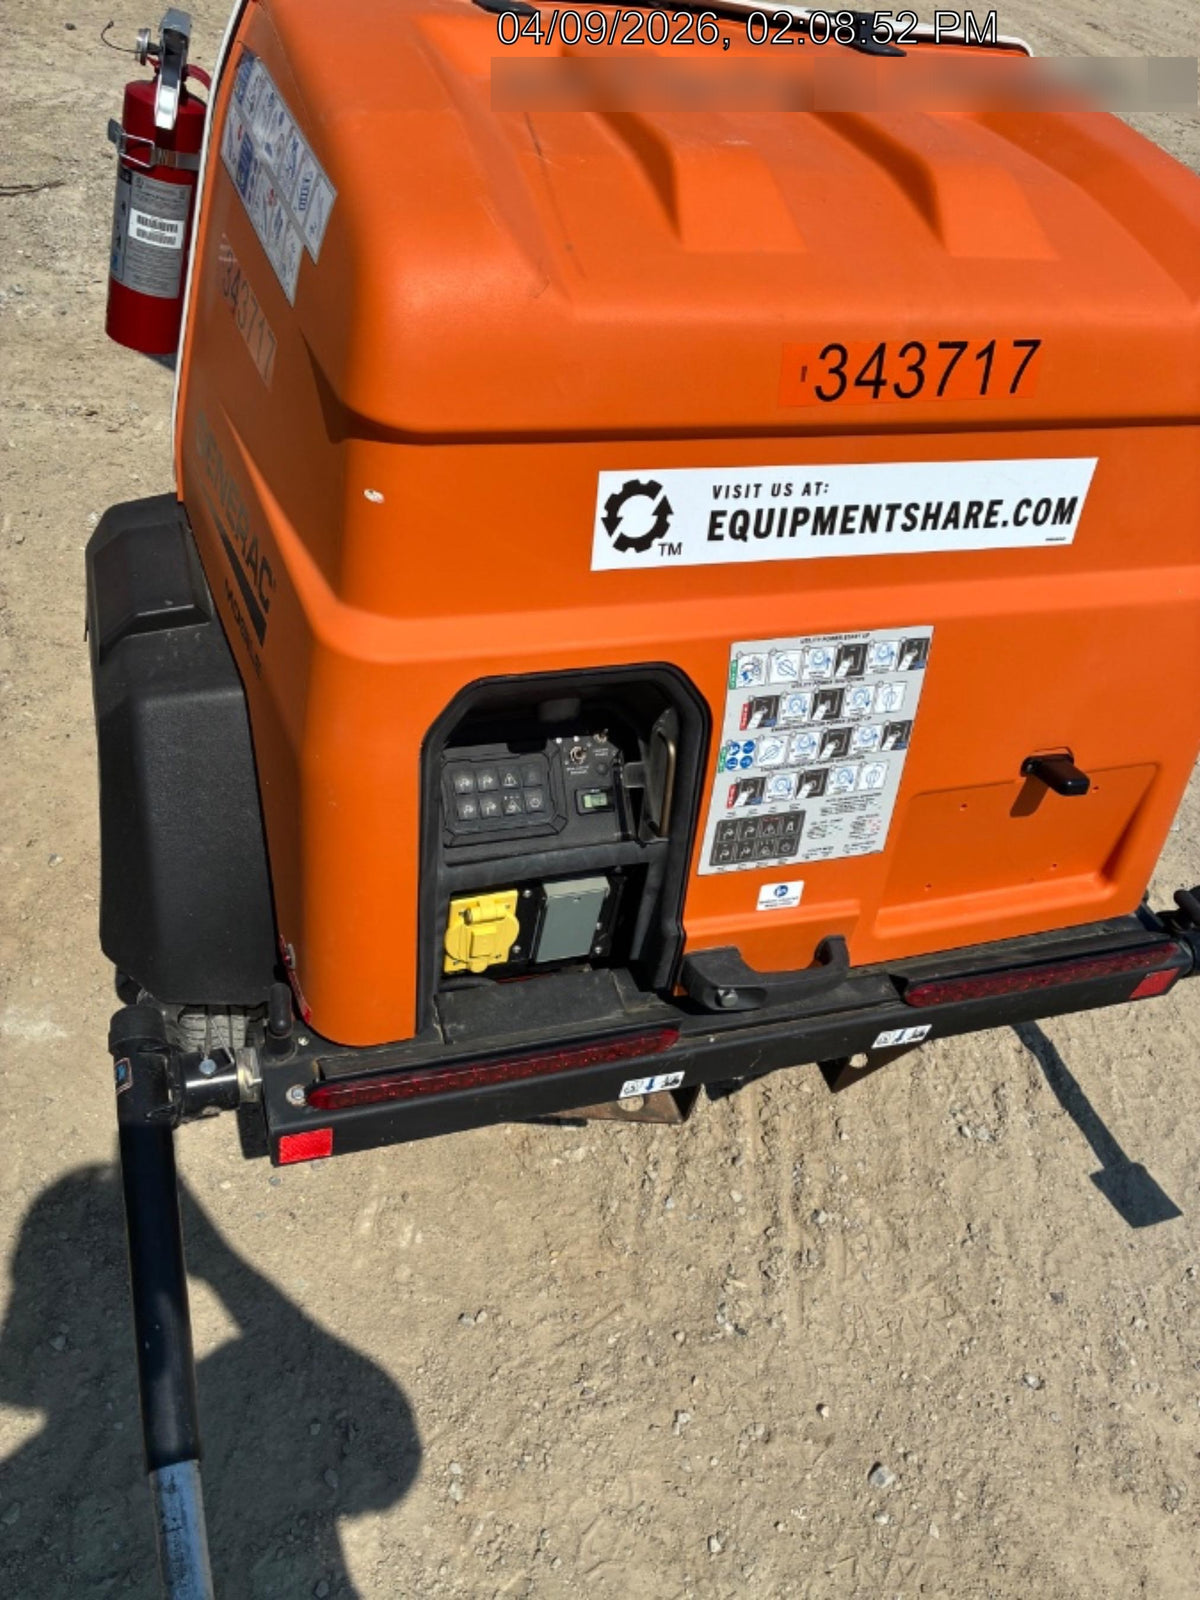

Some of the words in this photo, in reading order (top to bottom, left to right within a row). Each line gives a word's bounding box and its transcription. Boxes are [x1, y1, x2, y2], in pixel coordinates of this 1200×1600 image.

[815, 339, 1042, 402] 343717
[711, 483, 763, 501] VISIT
[770, 482, 794, 498] US
[801, 481, 830, 497] AT:
[706, 496, 1077, 542] EQUIPMENTSHARE.COM
[657, 541, 683, 557] TM
